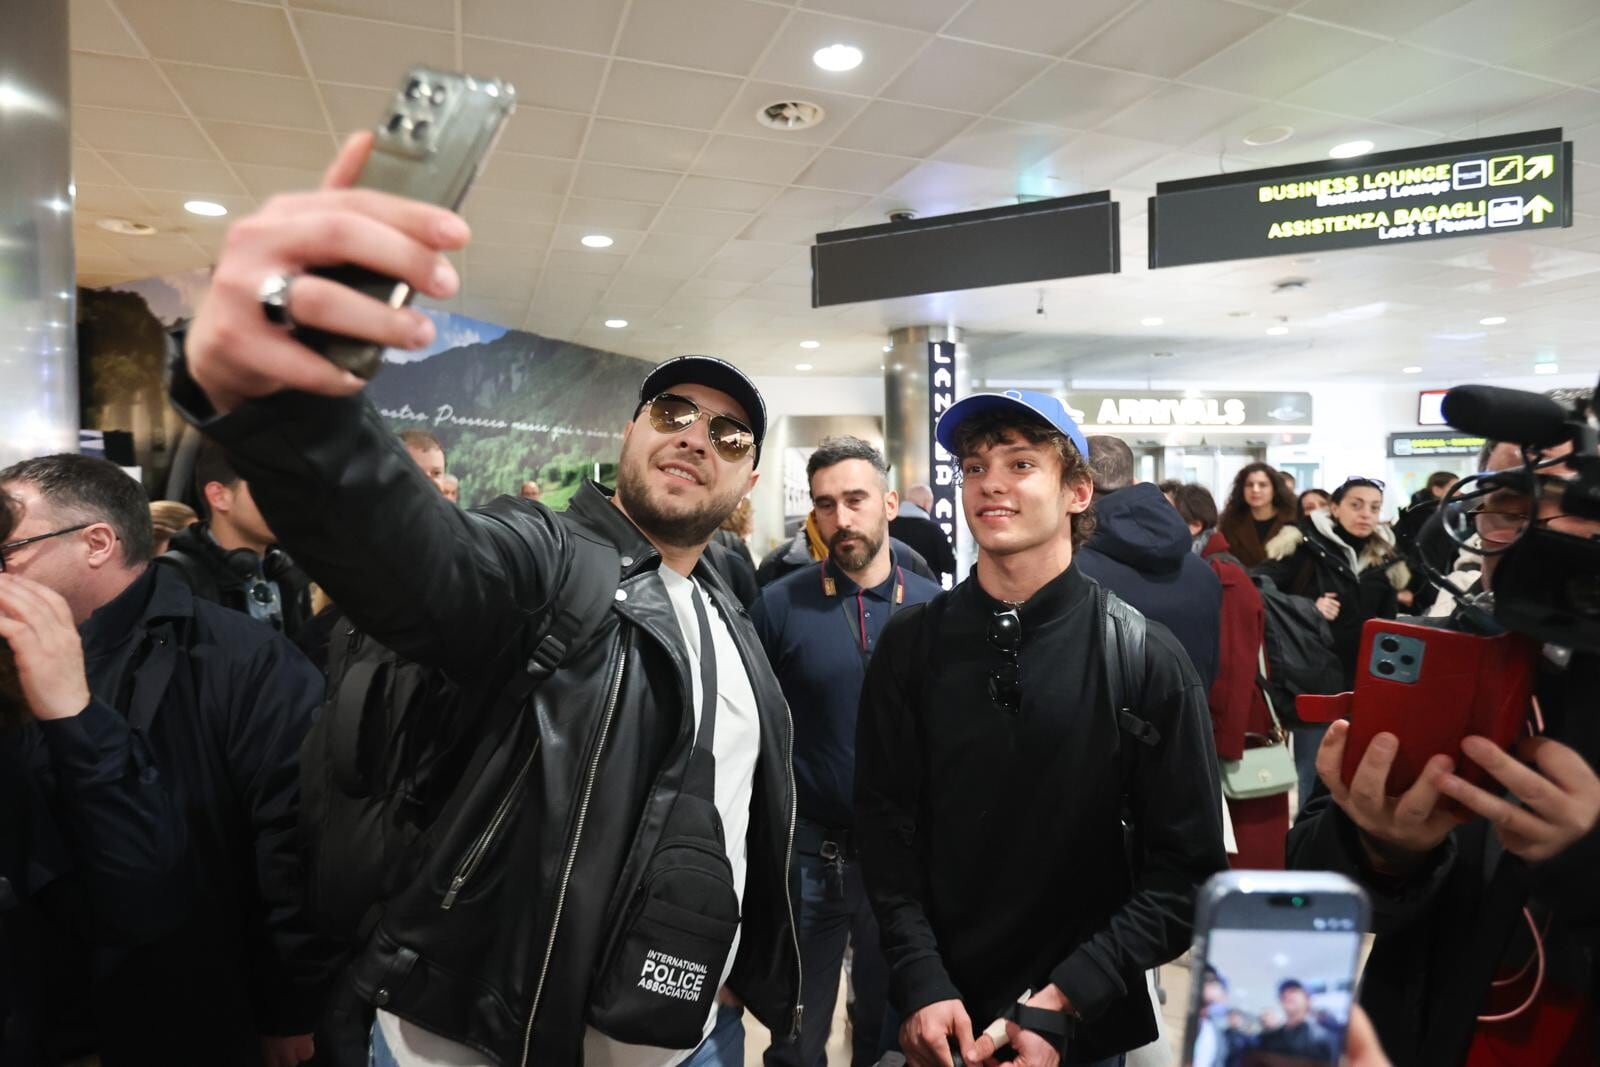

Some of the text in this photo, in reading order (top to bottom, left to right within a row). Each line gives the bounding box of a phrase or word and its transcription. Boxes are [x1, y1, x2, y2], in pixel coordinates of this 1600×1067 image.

[1259, 164, 1451, 203] BUSINESS LOUNGE
[1268, 200, 1487, 239] ASSISTENZA BAGAGLI
[1378, 224, 1416, 240] Lost
[380, 403, 429, 421] ostro
[1097, 398, 1246, 426] ARRIVALS
[647, 949, 708, 974] INTERNATIONAL
[637, 976, 701, 1002] ASSOCIATION
[641, 959, 705, 992] POLICE
